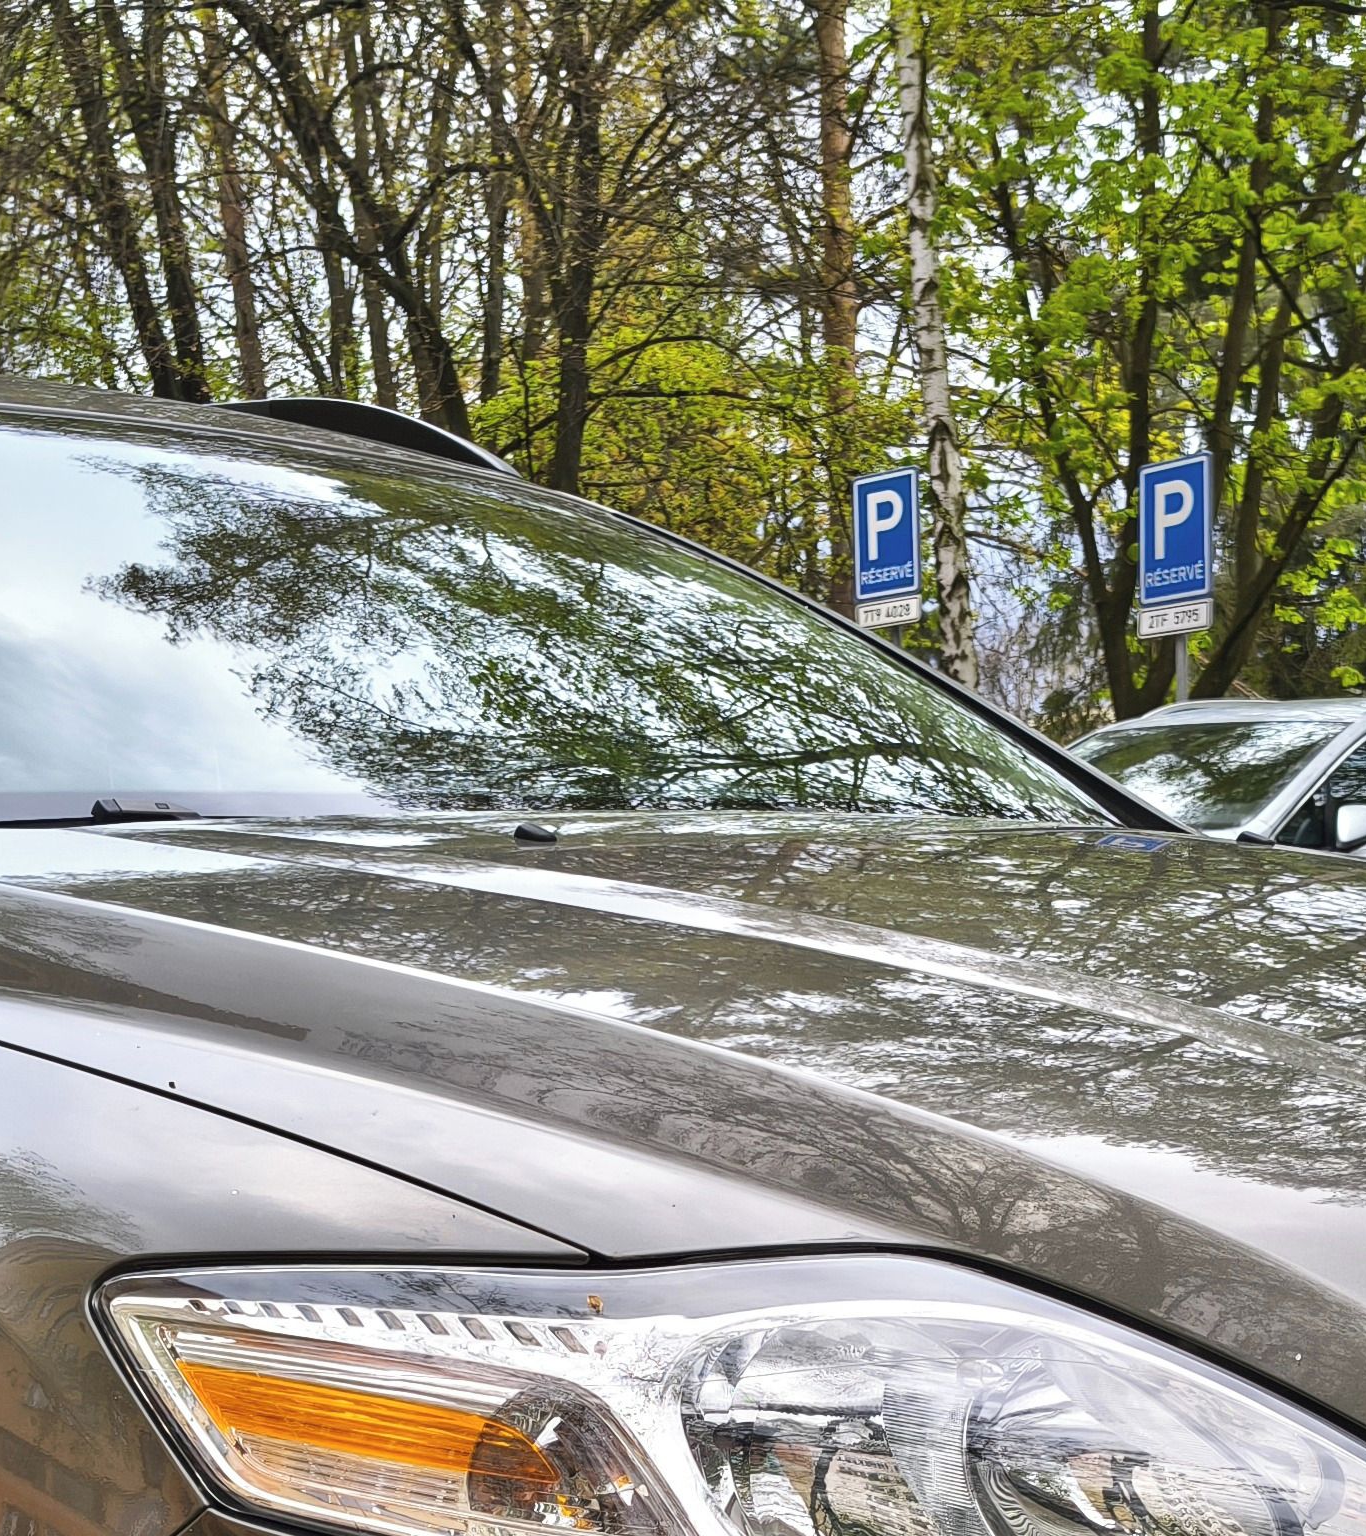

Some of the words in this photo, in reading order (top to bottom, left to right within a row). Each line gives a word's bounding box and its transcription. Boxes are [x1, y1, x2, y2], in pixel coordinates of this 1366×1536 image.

[866, 489, 904, 561] P
[1153, 479, 1195, 560] P
[860, 560, 915, 585] RÉSERVÉ
[1145, 560, 1204, 588] RÉSERVÉ
